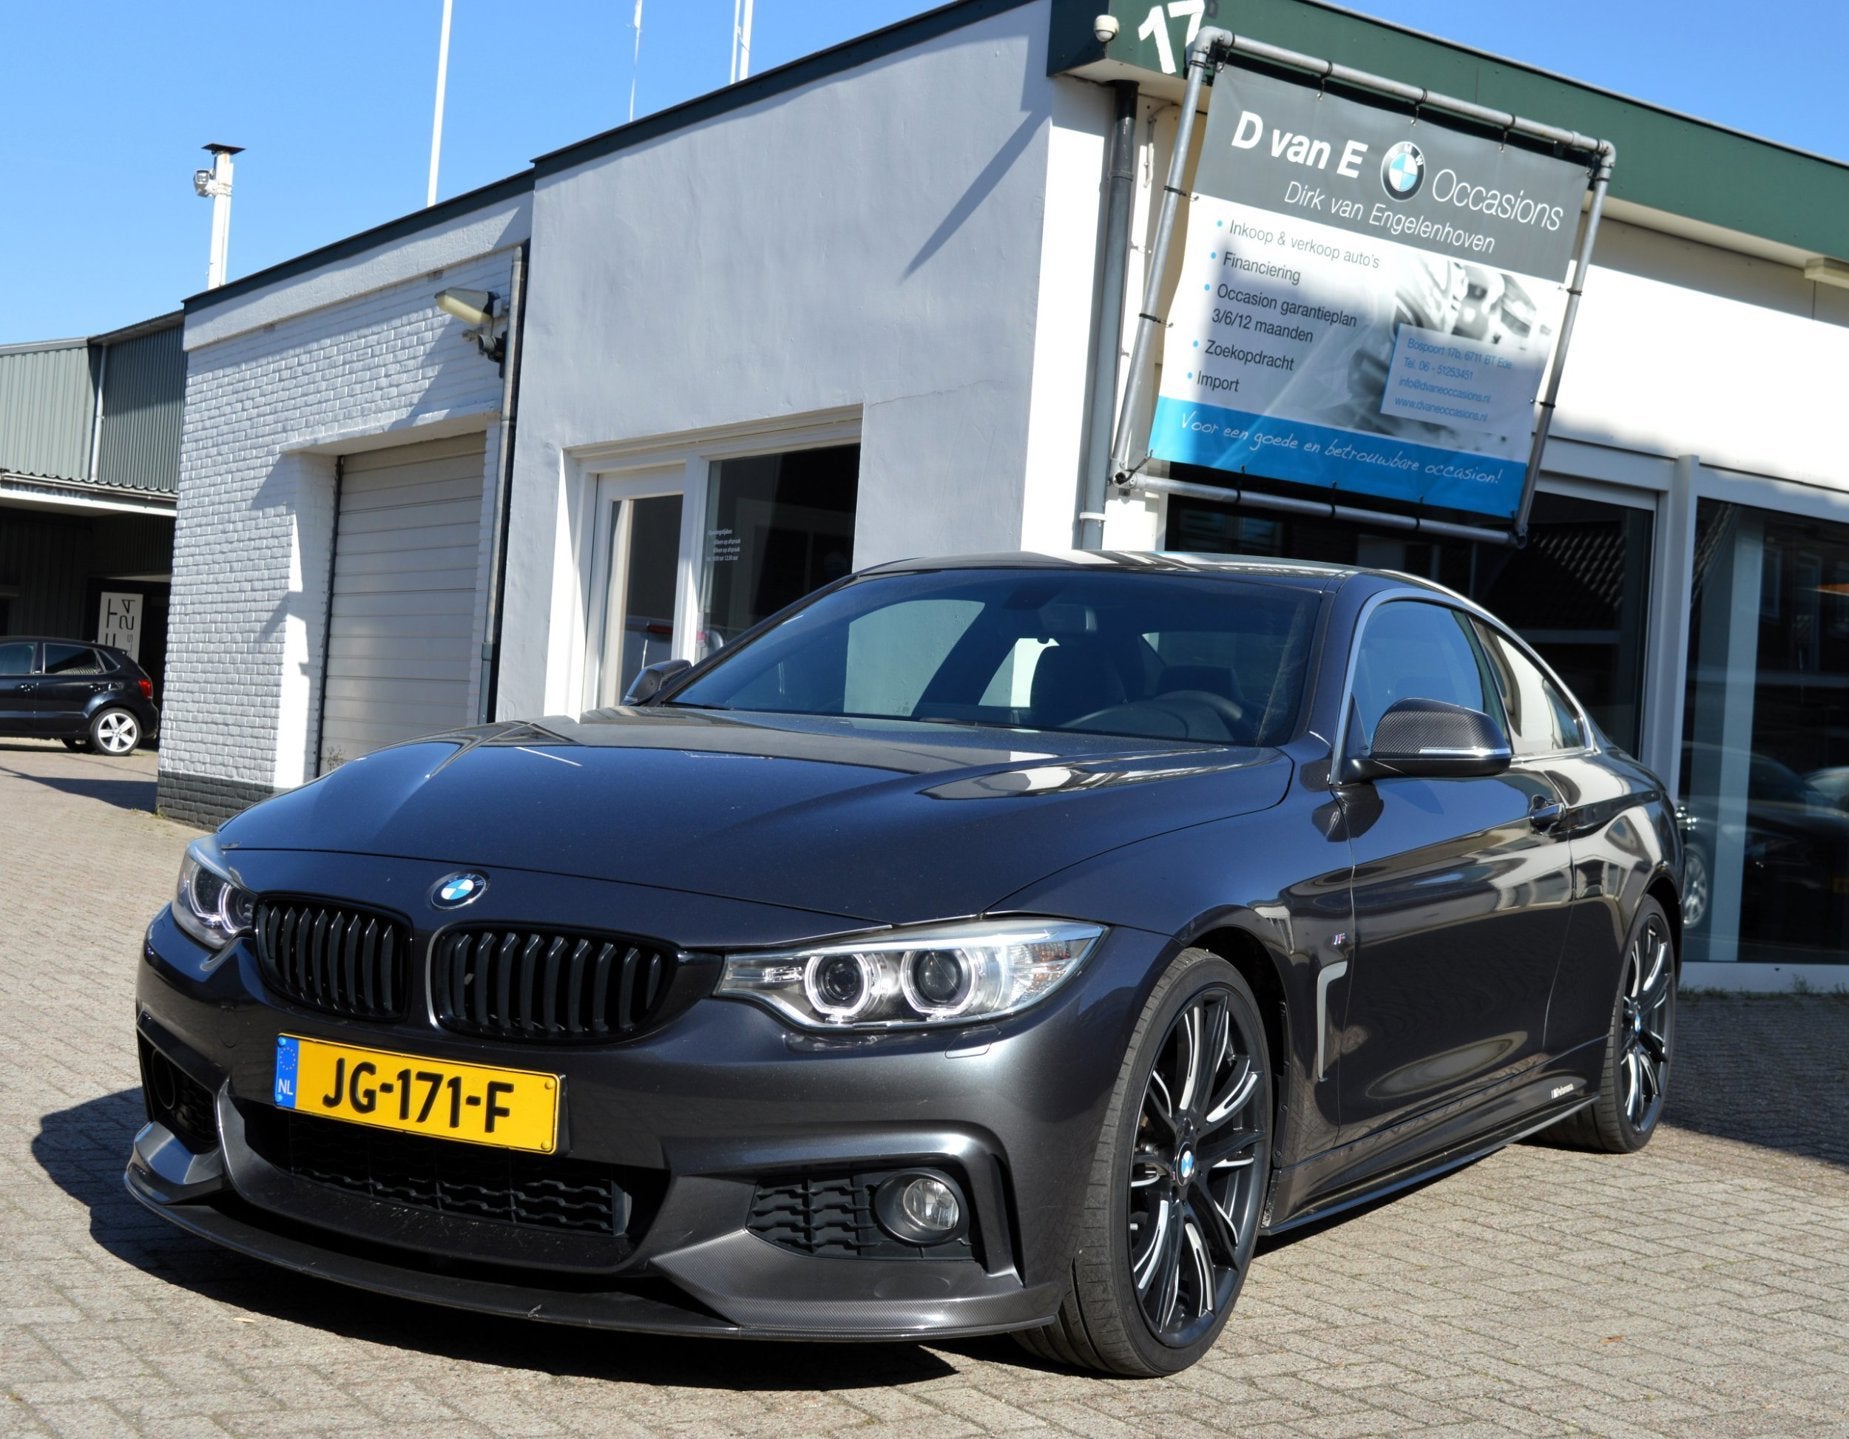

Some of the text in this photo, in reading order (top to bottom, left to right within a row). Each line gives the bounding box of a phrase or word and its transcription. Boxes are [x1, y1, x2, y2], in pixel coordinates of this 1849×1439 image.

[1138, 0, 1206, 74] 17
[1231, 111, 1263, 149] D
[1271, 129, 1331, 169] van
[1336, 140, 1369, 179] E
[1432, 169, 1564, 231] Occasions
[1284, 181, 1496, 254] Dirk van Engelenhoven
[1229, 219, 1381, 269] Inkoop & verkoop auto's
[1223, 251, 1301, 286] Financiering
[1217, 283, 1358, 328] Occasion garantieplan
[1212, 308, 1314, 343] 3/6/12 maanden
[1205, 339, 1294, 371] Zoekopdracht
[1407, 338, 1445, 356] Bospoort
[1464, 350, 1482, 363] 6711
[1497, 358, 1512, 369] Ede
[1418, 361, 1430, 373] 06
[1436, 363, 1473, 381] 51253451
[1197, 370, 1240, 393] Import
[1399, 377, 1491, 404] info@dvaneoccasions.nl
[1394, 396, 1489, 422] www.dvaneoccasions.nl
[1181, 410, 1503, 484] Voor een goede en betrouwbare occasion!
[277, 1078, 294, 1096] NL
[322, 1057, 515, 1134] JG-171-F
